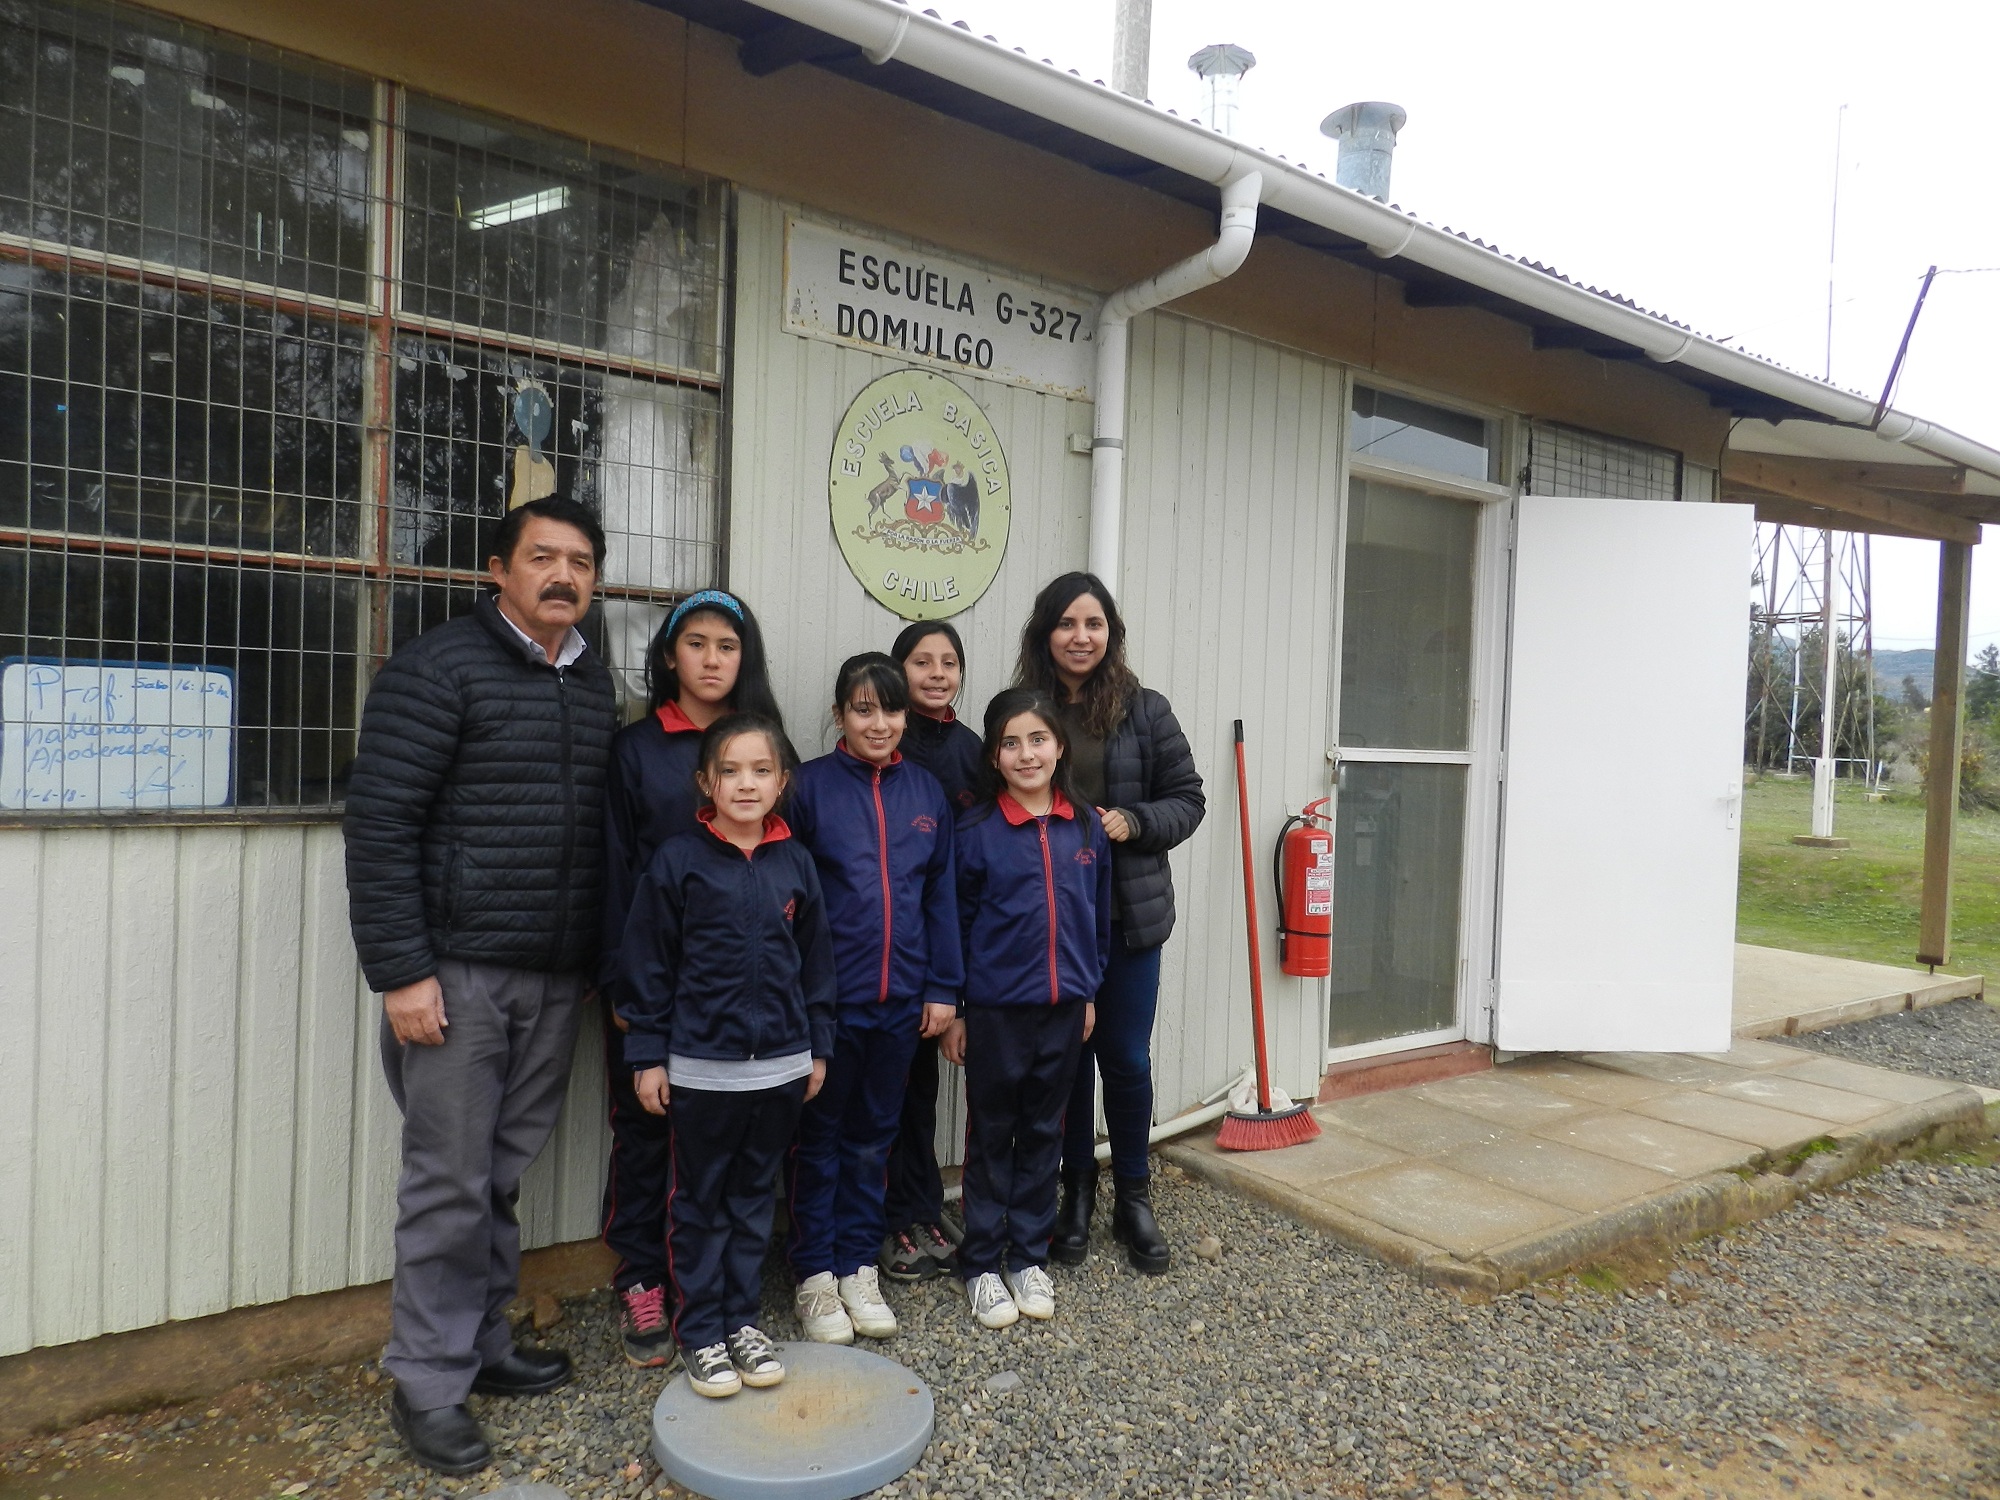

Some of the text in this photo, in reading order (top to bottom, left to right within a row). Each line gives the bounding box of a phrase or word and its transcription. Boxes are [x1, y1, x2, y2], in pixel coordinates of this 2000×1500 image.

[839, 248, 1082, 343] ESCUELA G-327
[837, 303, 994, 370] DOMULGO
[840, 391, 1002, 495] ESCUELA BASICA
[883, 569, 960, 602] CHILE
[162, 726, 213, 740] con
